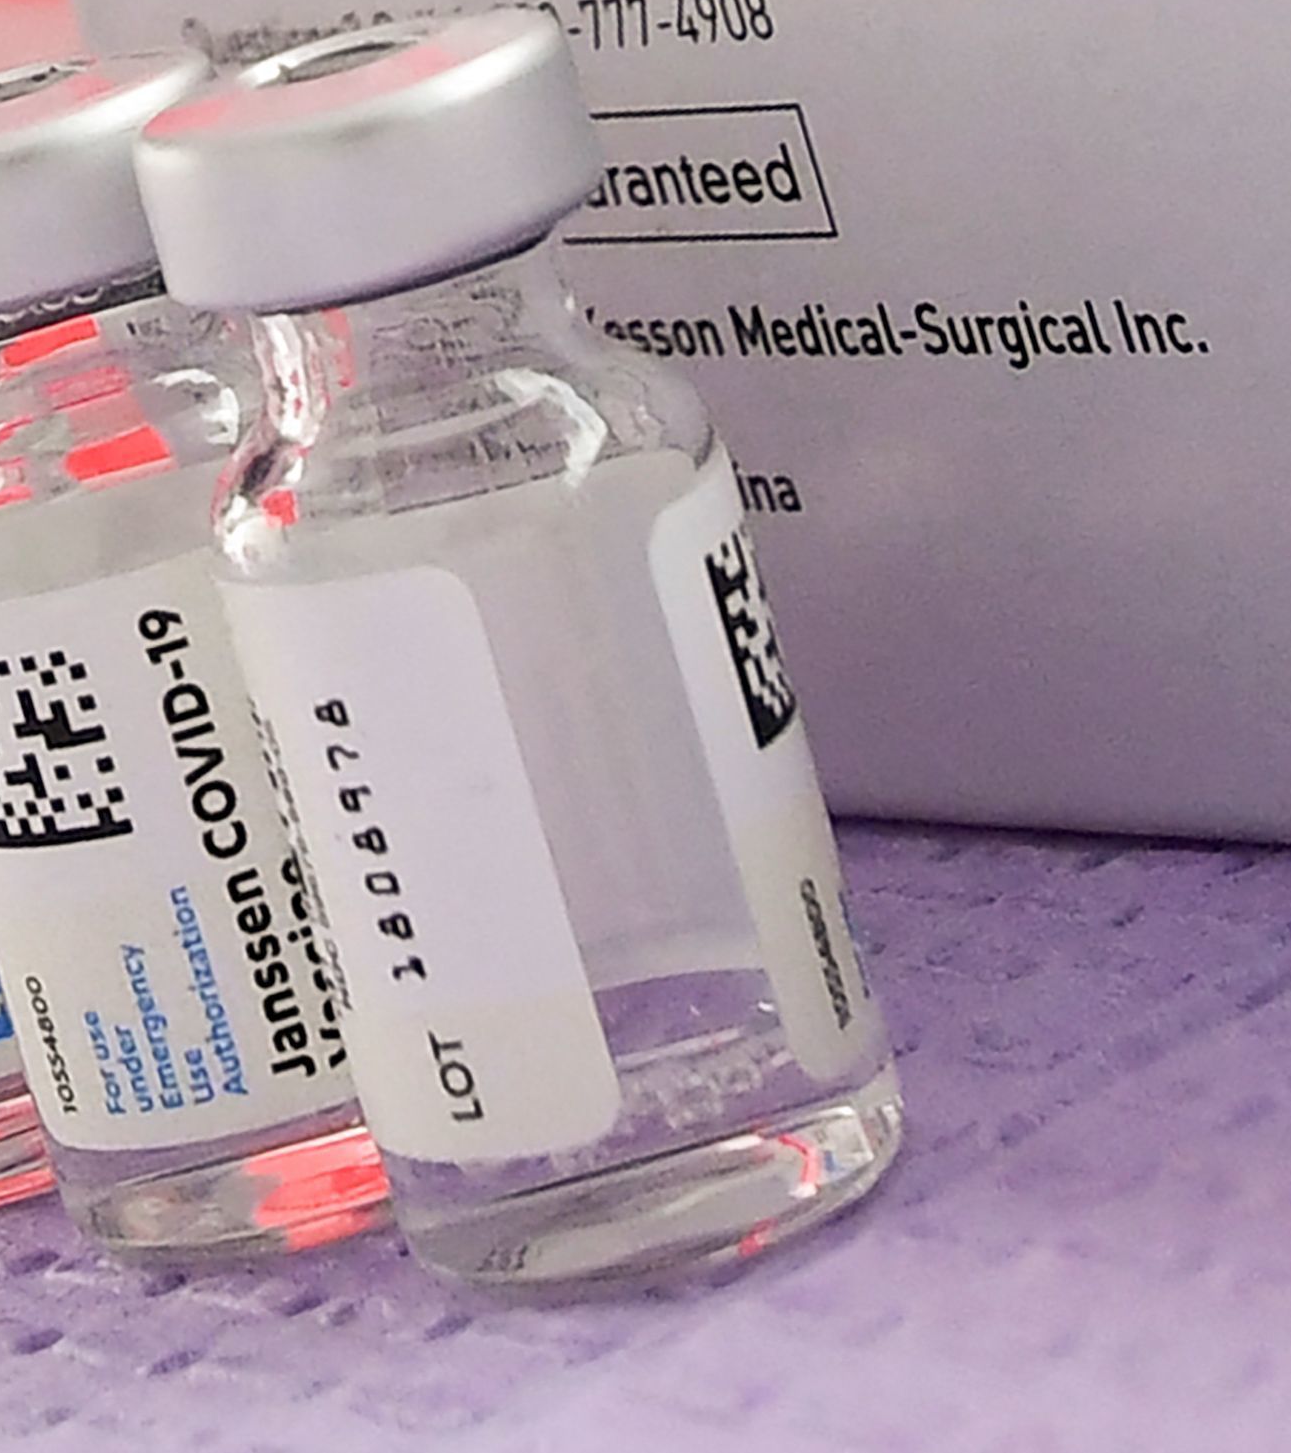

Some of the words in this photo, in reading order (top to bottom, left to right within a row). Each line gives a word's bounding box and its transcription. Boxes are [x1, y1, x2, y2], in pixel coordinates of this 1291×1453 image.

[727, 298, 1113, 371] Medical-Surgical
[1113, 298, 1210, 355] Inc.
[136, 608, 249, 861] COVID-19
[314, 697, 428, 982] 1808978
[120, 941, 186, 1111] Emergency
[168, 884, 251, 1097] Authorization
[226, 867, 319, 1079] Janssen
[24, 974, 79, 1114] 10554800
[83, 1008, 112, 1062] use
[100, 1061, 128, 1116] For
[115, 1023, 155, 1113] under
[183, 1047, 216, 1107] Use
[427, 1029, 485, 1124] LOT
